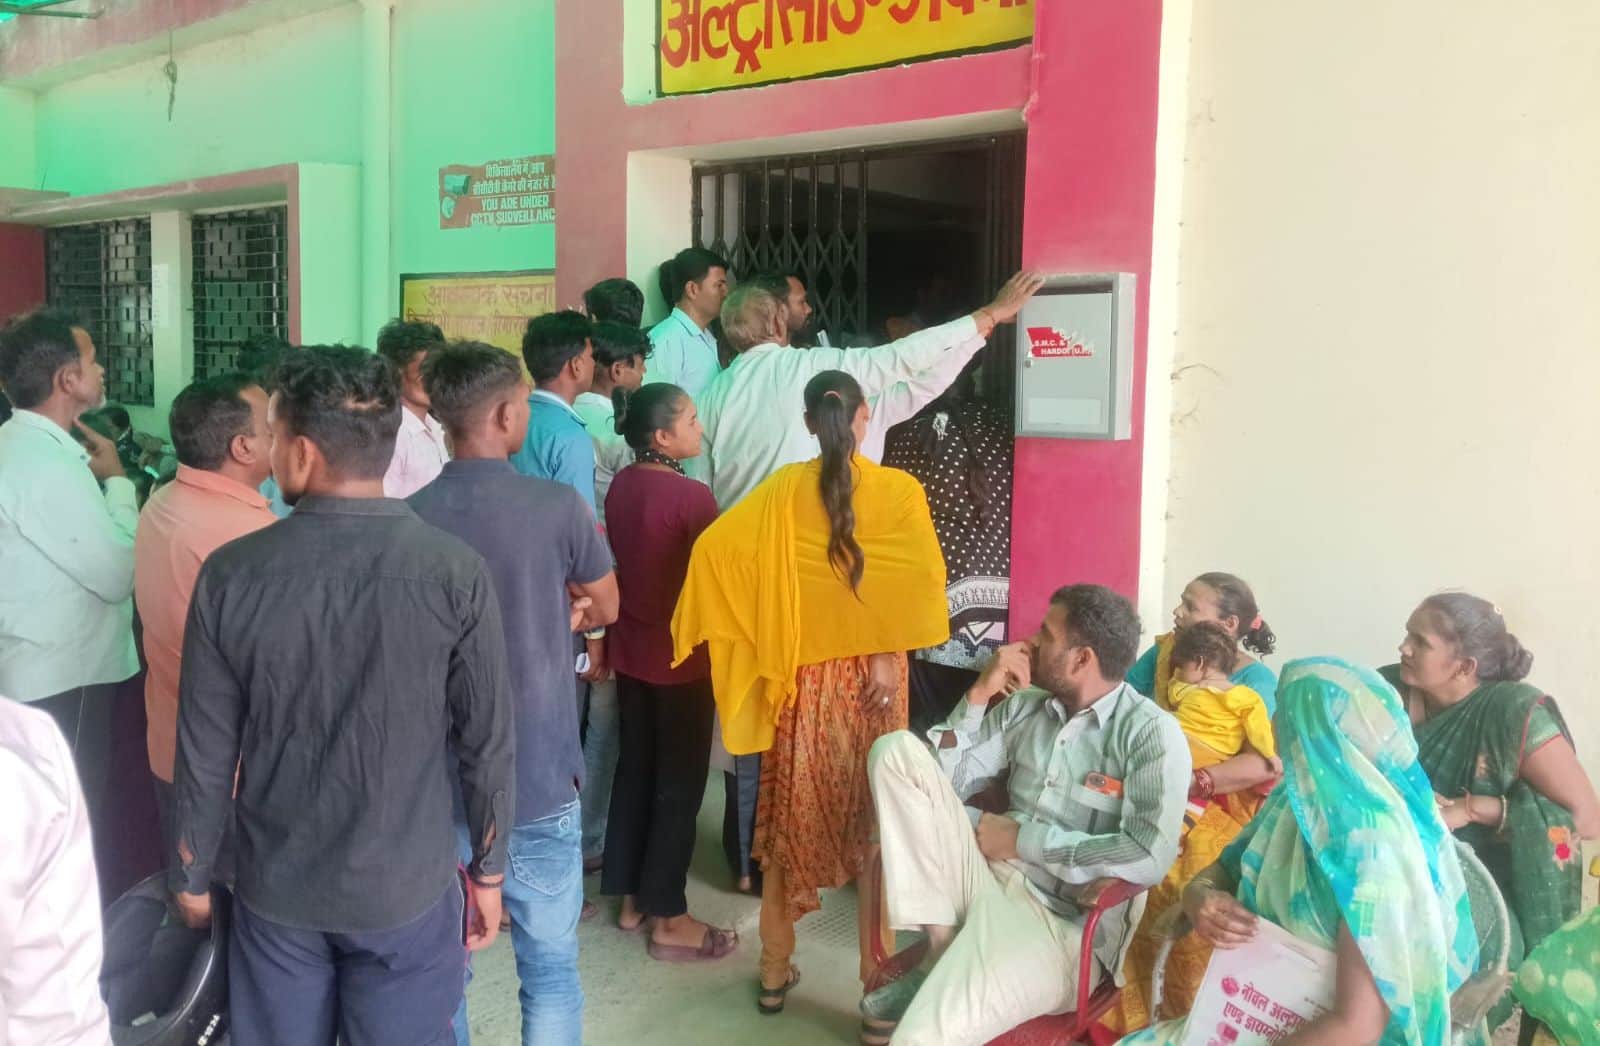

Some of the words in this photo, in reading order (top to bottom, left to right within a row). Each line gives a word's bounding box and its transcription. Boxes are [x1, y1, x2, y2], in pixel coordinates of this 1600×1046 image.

[481, 197, 498, 211] YOU
[500, 195, 519, 210] ARE
[519, 193, 549, 209] UNDER
[495, 207, 556, 225] SURVEILLANC
